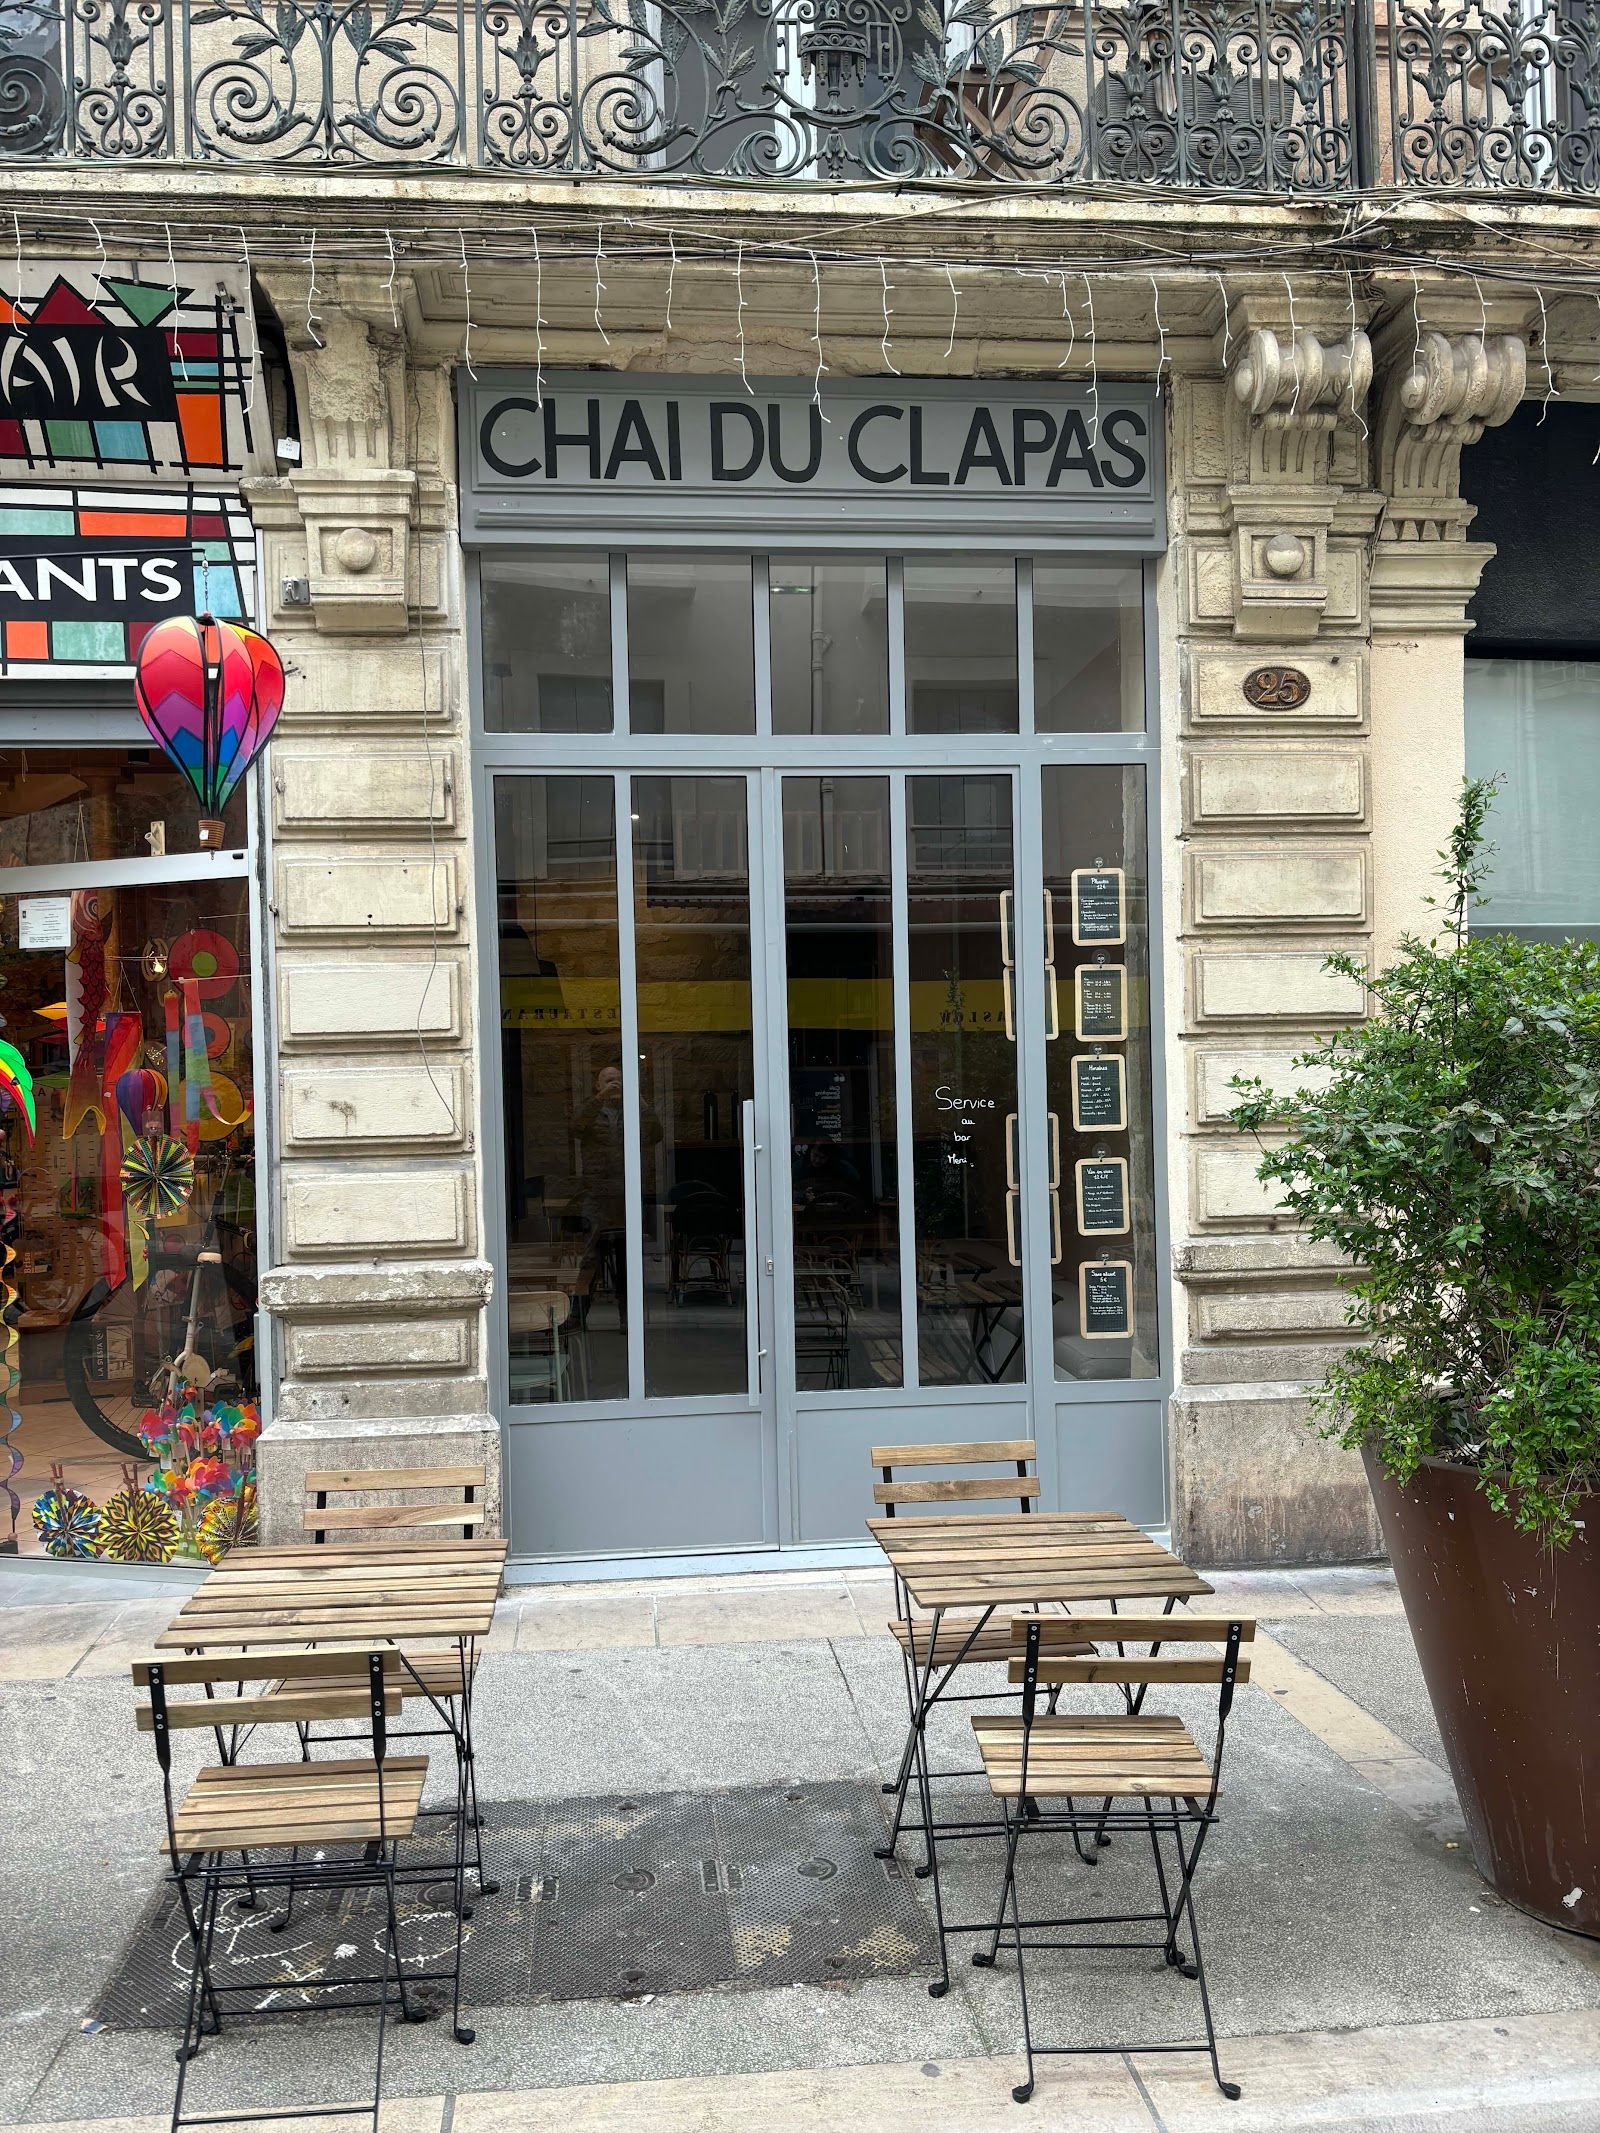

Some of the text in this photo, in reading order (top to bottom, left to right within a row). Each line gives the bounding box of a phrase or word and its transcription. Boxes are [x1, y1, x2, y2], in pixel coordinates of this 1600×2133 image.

[0, 335, 152, 408] AIR
[479, 397, 1148, 489] CHAI DU CLAPAS
[0, 557, 182, 602] ANTS
[1257, 671, 1300, 703] 25
[935, 1085, 996, 1110] Service
[953, 1131, 972, 1142] bar
[23, 1252, 32, 1274] Brisa
